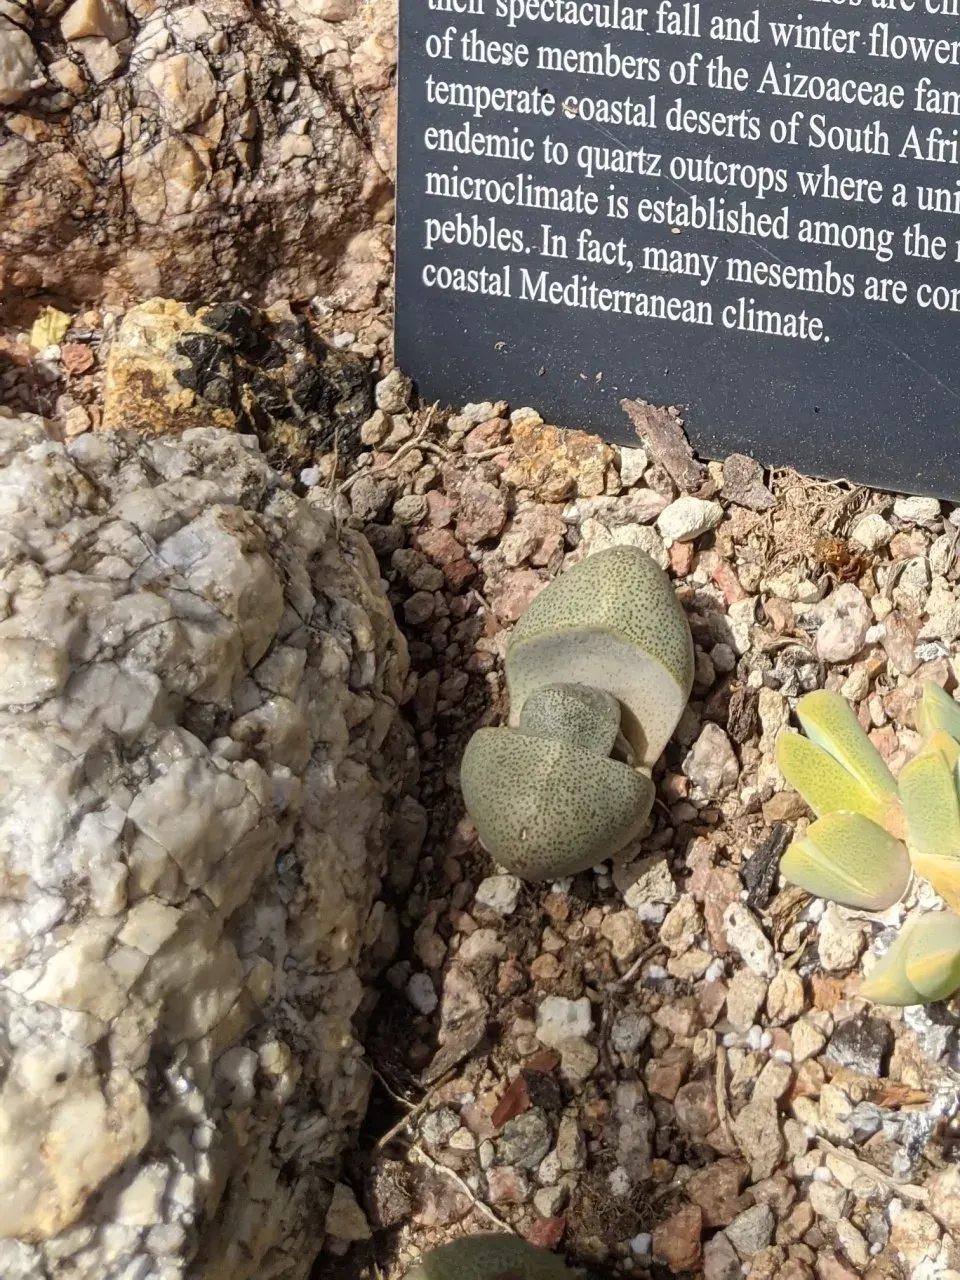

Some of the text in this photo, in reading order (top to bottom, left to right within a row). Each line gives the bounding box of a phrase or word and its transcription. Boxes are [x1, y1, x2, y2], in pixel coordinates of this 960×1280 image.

[425, 26, 458, 60] of
[460, 28, 530, 68] these
[536, 42, 661, 82] members
[669, 52, 703, 86] of
[705, 54, 749, 92] the
[756, 60, 905, 110] Aizoaceae
[655, 0, 702, 38] fall
[709, 9, 761, 44] and
[768, 13, 861, 54] winter
[425, 74, 556, 118] temperate
[561, 94, 657, 129] coastal
[665, 97, 761, 141] deserts
[769, 111, 805, 145] of
[808, 113, 891, 156] South
[423, 121, 535, 162] endemic
[542, 134, 569, 166] to
[576, 145, 662, 179] quartz
[669, 154, 788, 200] outcrops
[796, 163, 884, 205] where
[891, 183, 909, 208] a
[424, 166, 599, 216] microclimate
[606, 183, 629, 220] is
[637, 194, 790, 240] established
[797, 218, 895, 263] among
[902, 222, 947, 261] the
[423, 212, 531, 255] pebbles.
[539, 223, 569, 259] In
[575, 228, 634, 274] fact,
[639, 246, 719, 287] many
[725, 257, 855, 298] mesembs
[863, 276, 908, 305] are
[421, 263, 830, 343] coastal Mediterranean climate.
